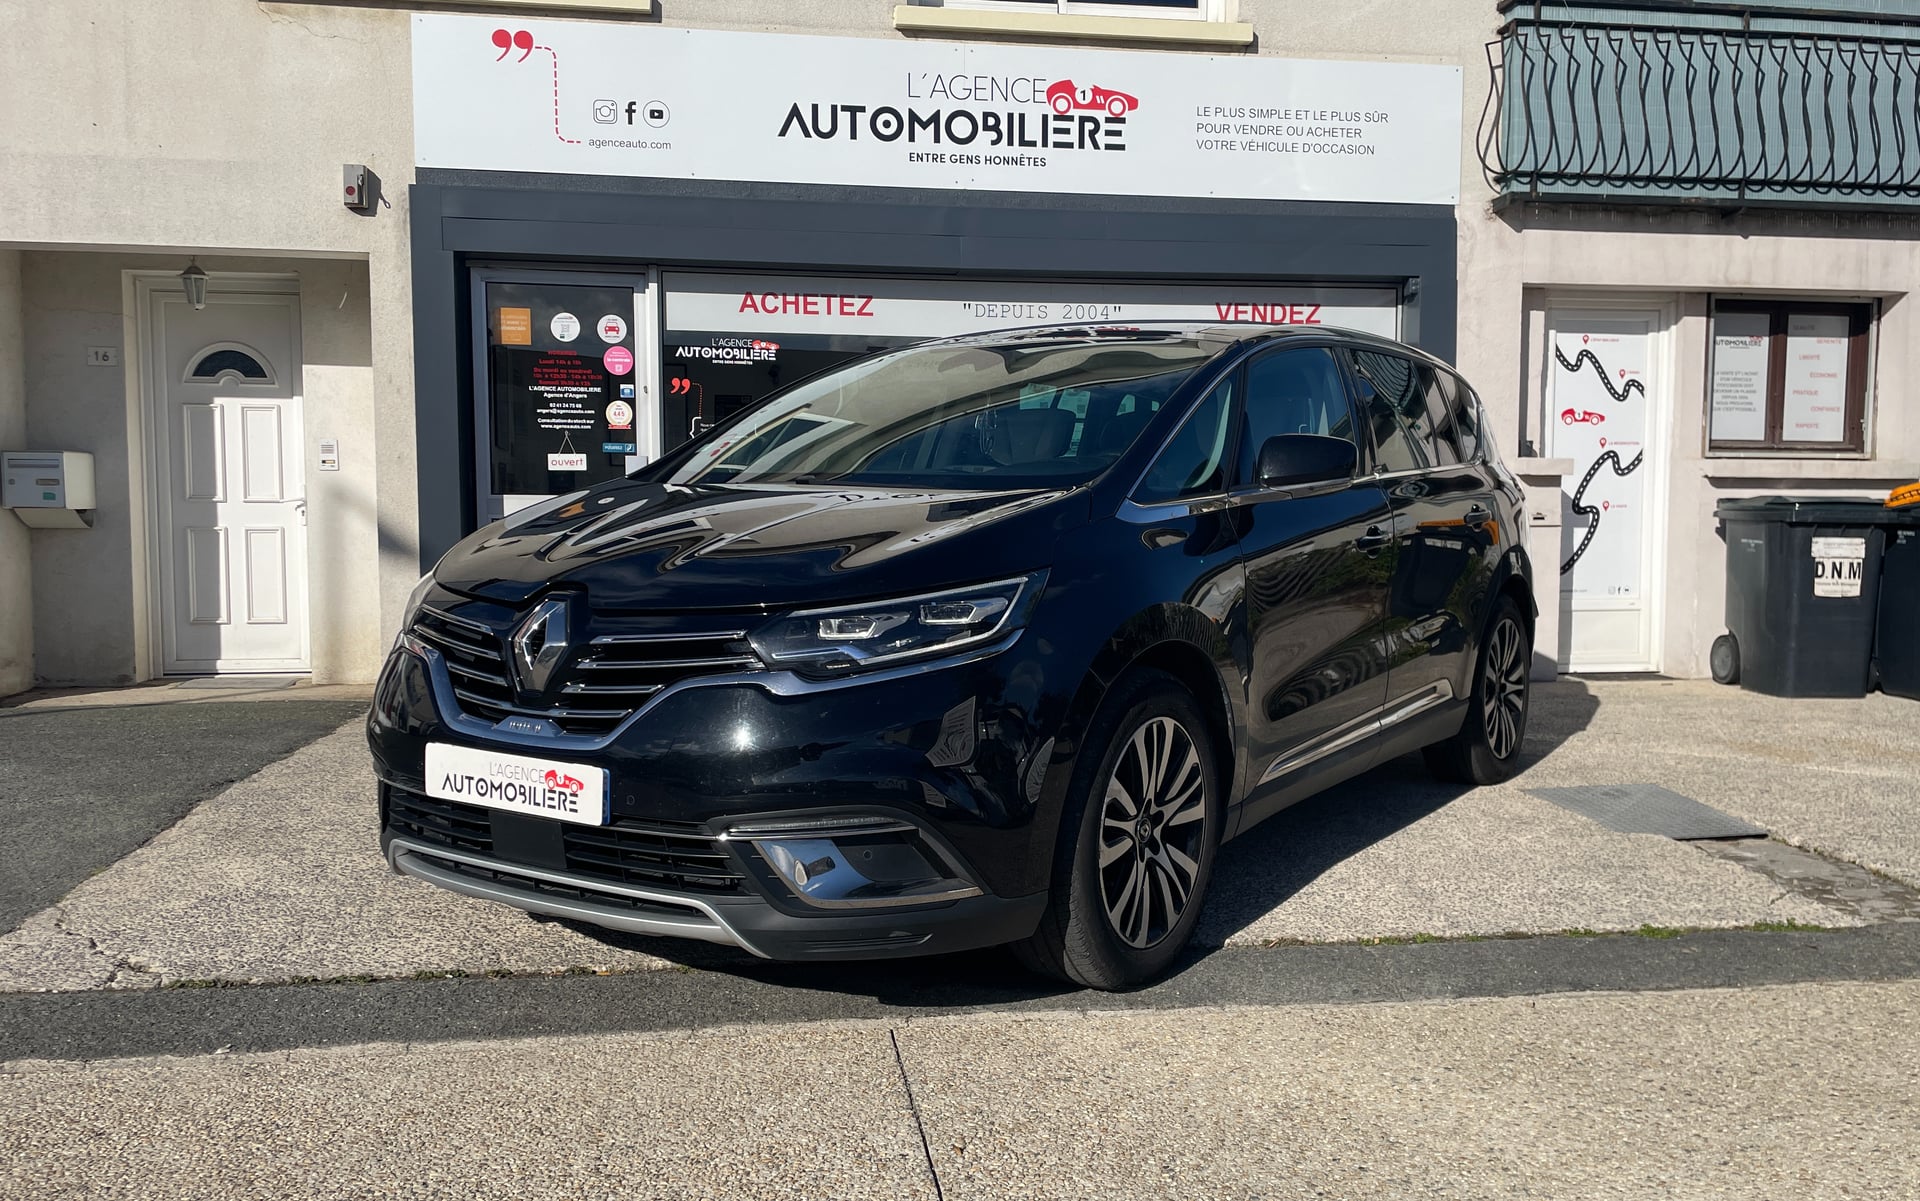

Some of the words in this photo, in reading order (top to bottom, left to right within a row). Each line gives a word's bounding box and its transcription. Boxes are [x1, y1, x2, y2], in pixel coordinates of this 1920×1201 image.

[907, 72, 1047, 103] L'AGENCE
[1196, 106, 1211, 117] LE
[1215, 107, 1245, 118] PLUS
[1249, 108, 1292, 120] SIMPLE
[1295, 110, 1310, 120] ET
[1313, 110, 1327, 121] LE
[1331, 111, 1361, 122] PLUS
[1364, 110, 1389, 123] SÛR
[1196, 123, 1231, 134] POUR
[1234, 124, 1283, 136] VENDRE
[1286, 126, 1304, 137] OU
[1306, 127, 1362, 138] ACHETER
[588, 139, 672, 150] agenceauto.com
[1196, 139, 1237, 151] VOTRE
[1240, 138, 1299, 153] VÉHICULE
[1302, 143, 1375, 155] D'OCCASION
[909, 152, 946, 164] ENTRE
[950, 154, 981, 165] GENS
[984, 153, 1047, 167] HONNÊTES
[739, 291, 874, 317] ACHETEZ
[963, 302, 1048, 319] "DEPUIS
[1062, 304, 1122, 320] 2004"
[1215, 302, 1322, 325] VENDEZ
[711, 338, 753, 347] L'AGENCE
[94, 350, 110, 361] 16
[551, 457, 583, 466] ouvert
[489, 761, 545, 784] L'AGENCE
